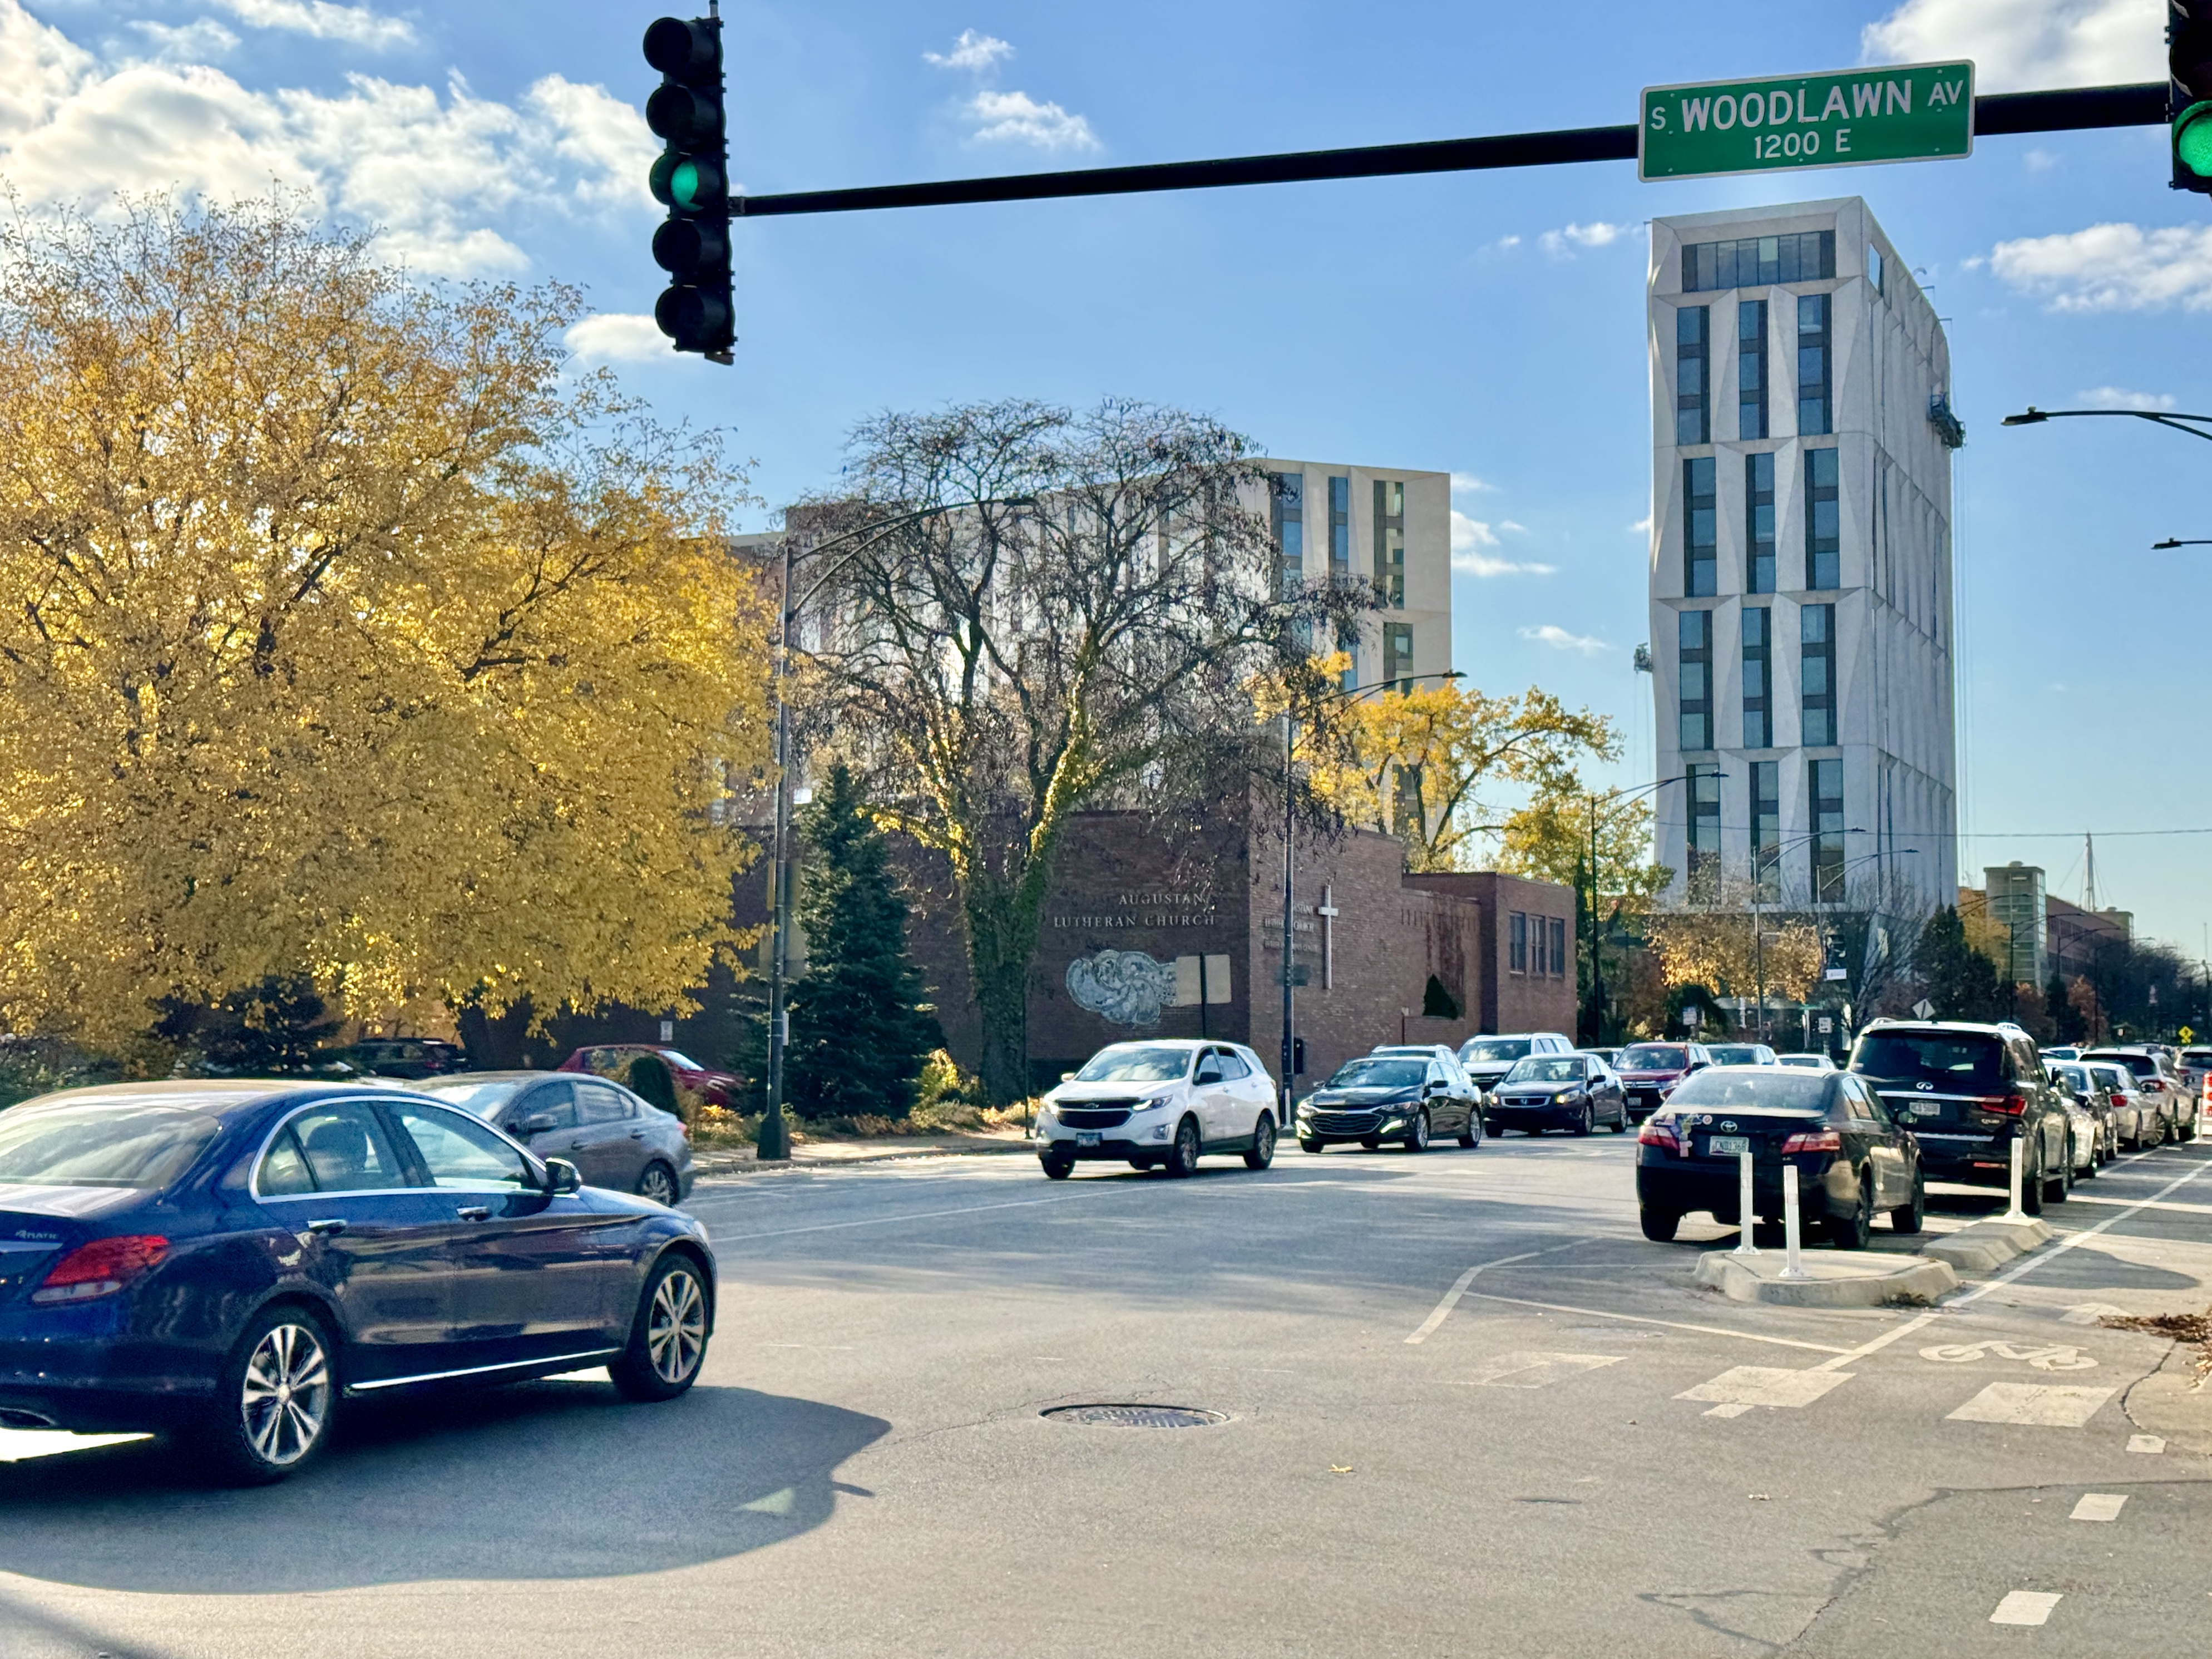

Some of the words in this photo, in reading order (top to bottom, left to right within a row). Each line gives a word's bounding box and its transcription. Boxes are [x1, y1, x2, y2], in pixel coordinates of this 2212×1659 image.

[1650, 107, 1666, 130] S
[1681, 79, 1912, 132] WOODLAWN
[1927, 80, 1964, 107] AV
[1754, 130, 1820, 159] 1200
[1835, 128, 1851, 152] E
[1054, 915, 1136, 928] LUTHERAN
[1145, 915, 1214, 927] CHURCH
